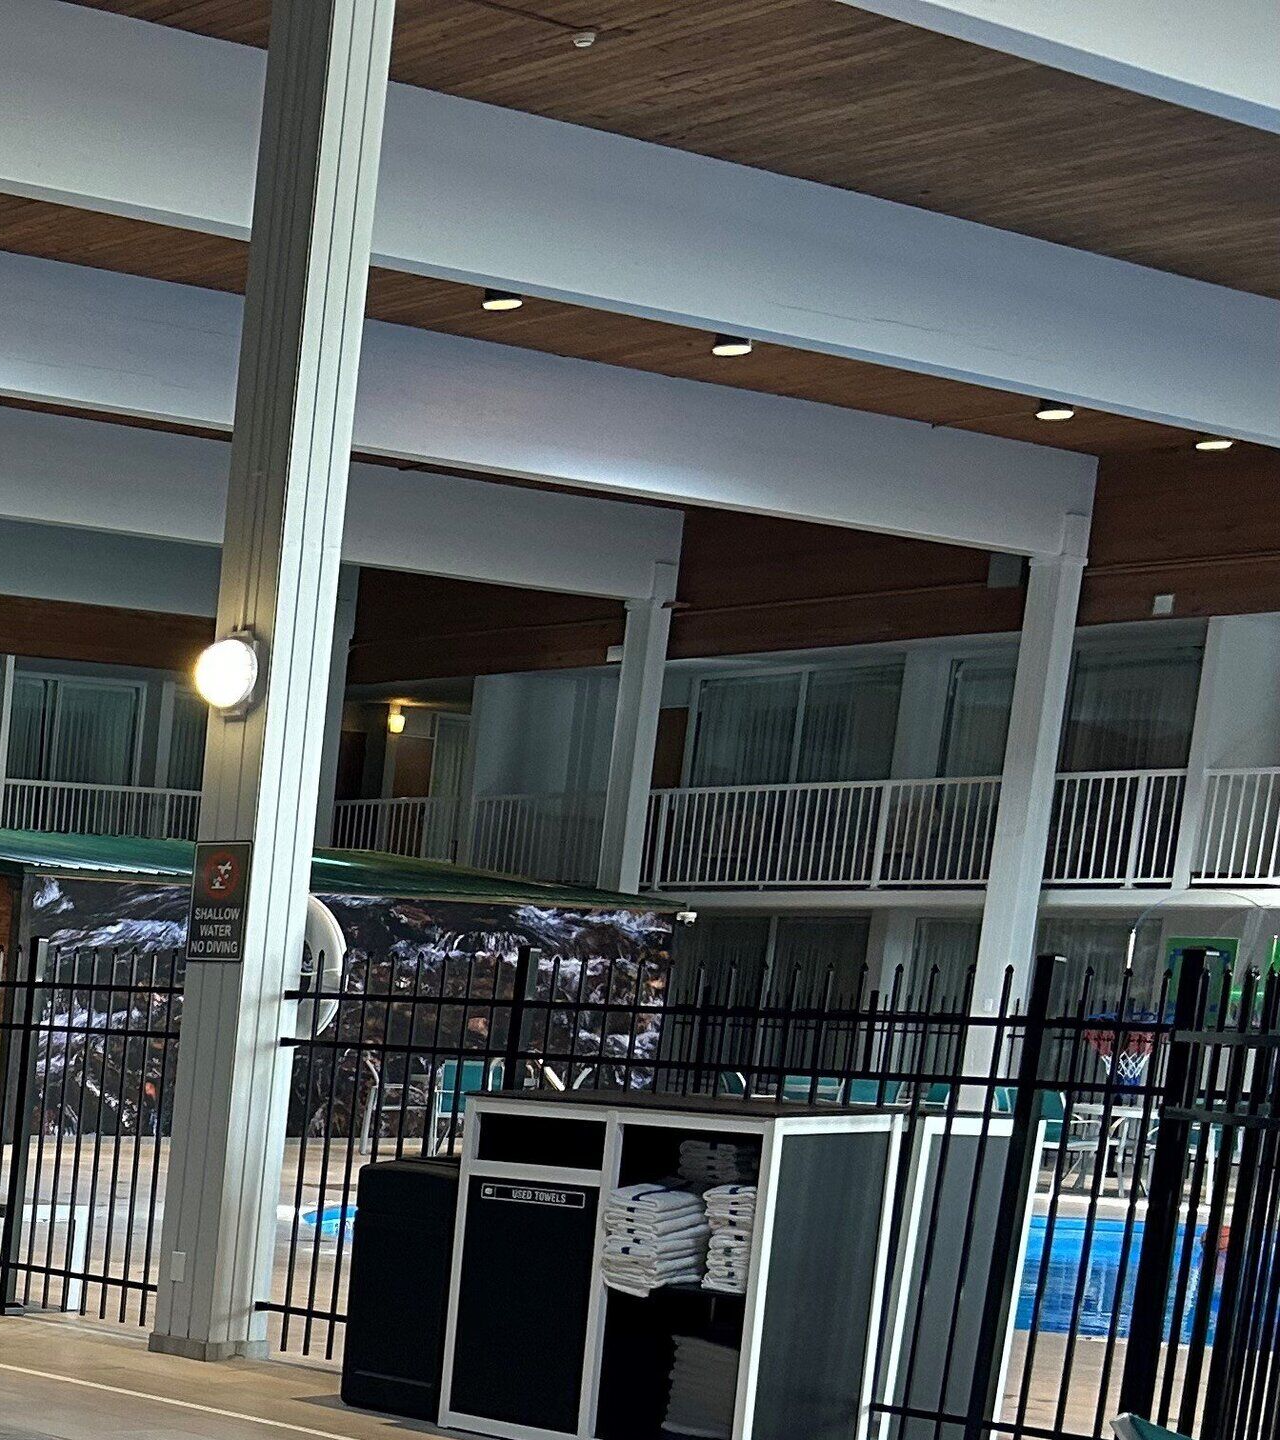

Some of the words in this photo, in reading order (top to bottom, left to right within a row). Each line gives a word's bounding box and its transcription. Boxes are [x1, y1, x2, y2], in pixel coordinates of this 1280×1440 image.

[194, 907, 240, 920] SHALLOW
[199, 924, 232, 937] WATER
[190, 941, 205, 953] NO
[206, 940, 238, 953] DIVING
[512, 1189, 532, 1200] USED
[534, 1191, 566, 1204] TOWELS
